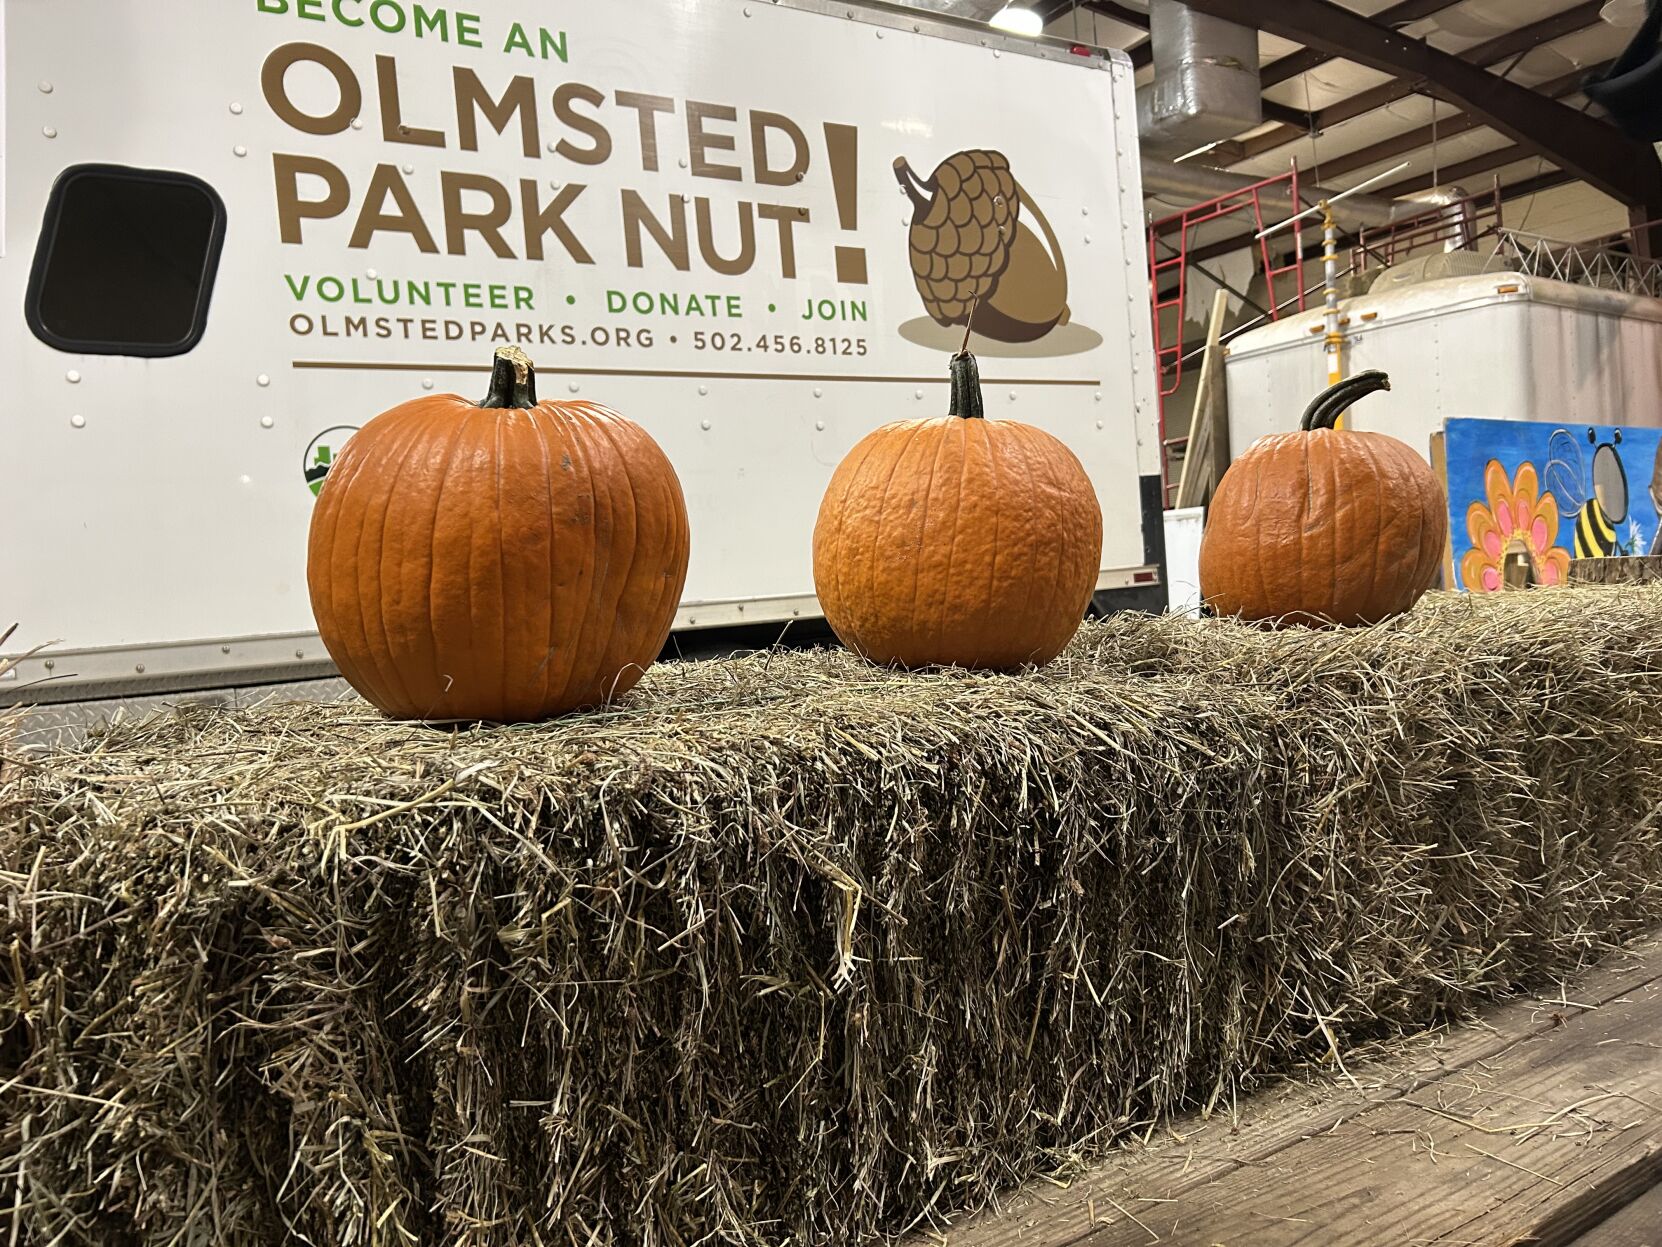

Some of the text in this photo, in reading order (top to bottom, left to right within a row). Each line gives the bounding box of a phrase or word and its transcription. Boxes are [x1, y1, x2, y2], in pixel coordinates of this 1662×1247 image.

[503, 23, 569, 63] AN
[261, 42, 810, 187] OLMSTED
[272, 152, 596, 266] PARK
[285, 274, 868, 322] VOLUNTEER DONATE JOIN
[289, 313, 868, 356] OLMSTEDPARKS.ORG 502.456.8125
